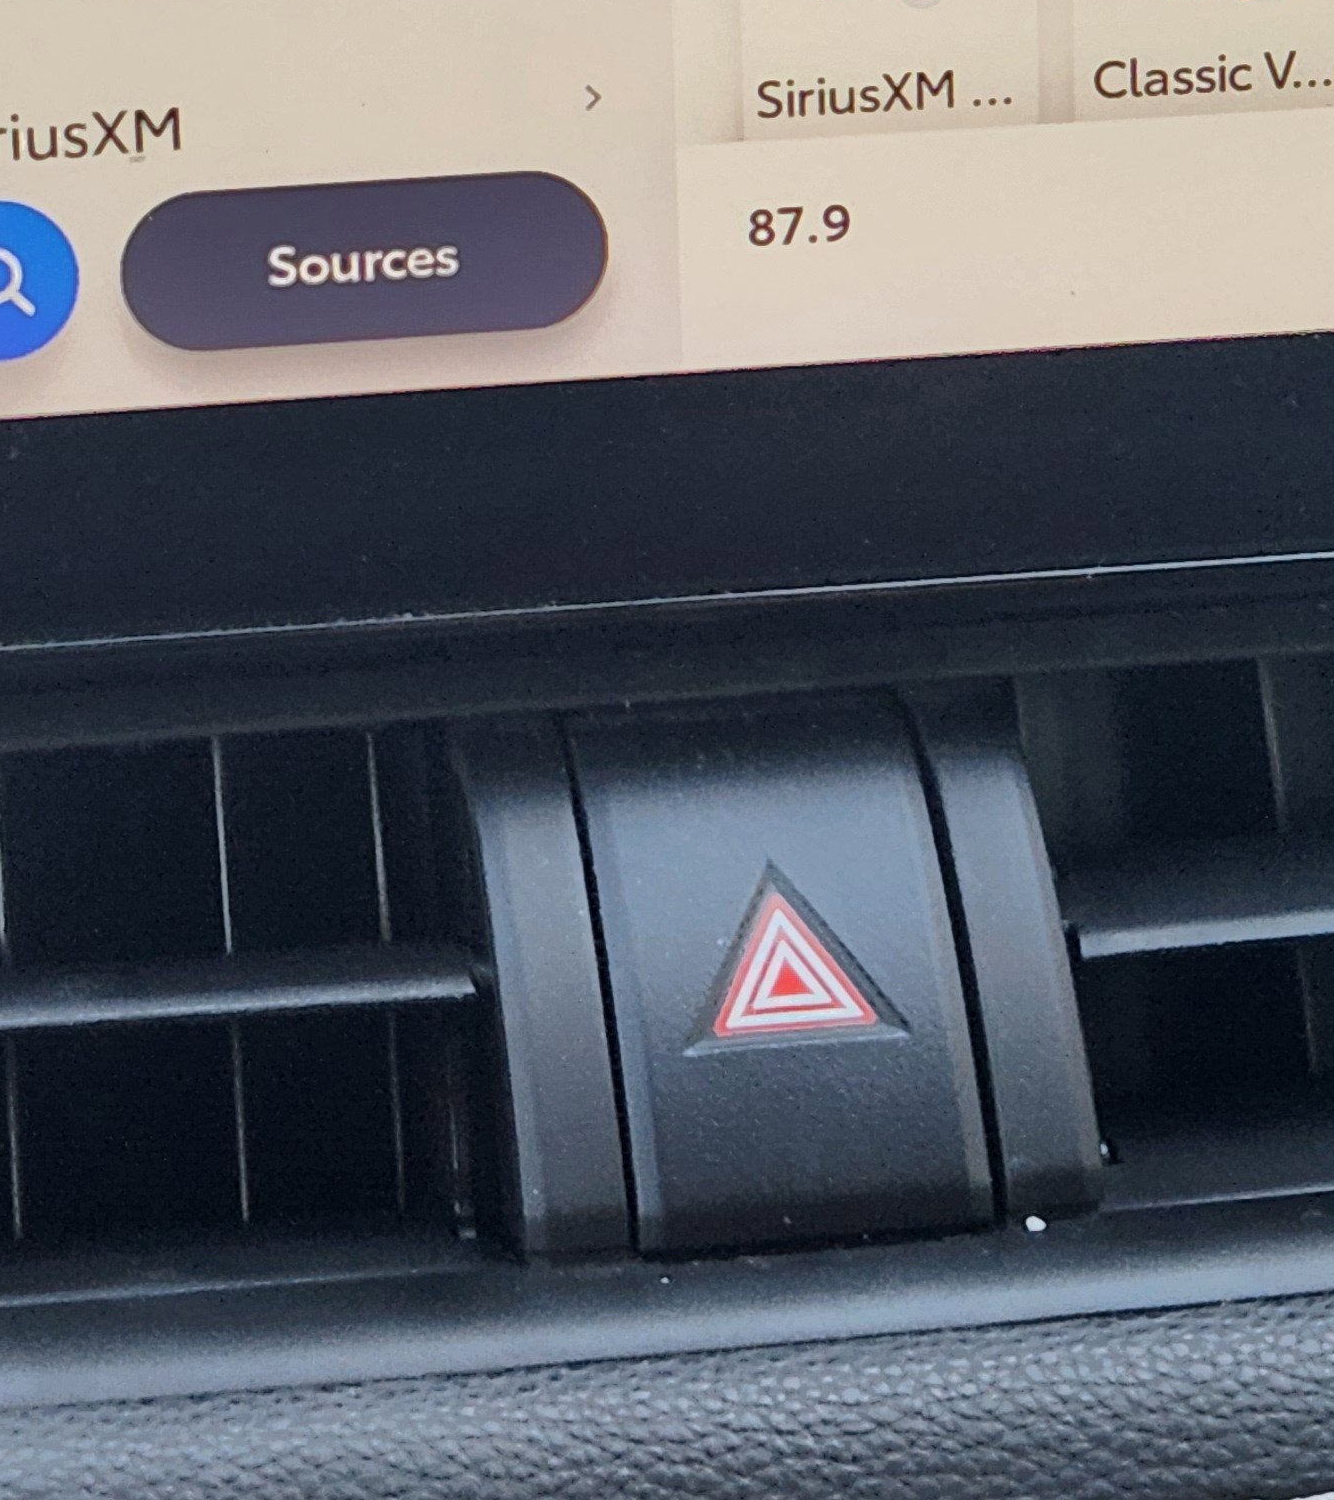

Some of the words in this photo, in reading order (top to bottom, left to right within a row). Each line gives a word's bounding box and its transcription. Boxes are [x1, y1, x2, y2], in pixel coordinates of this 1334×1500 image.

[757, 69, 955, 119] SiriusXM
[1093, 53, 1253, 99] Classic
[1263, 50, 1332, 90] V...
[748, 204, 851, 247] 87.9
[268, 244, 460, 288] Sources
